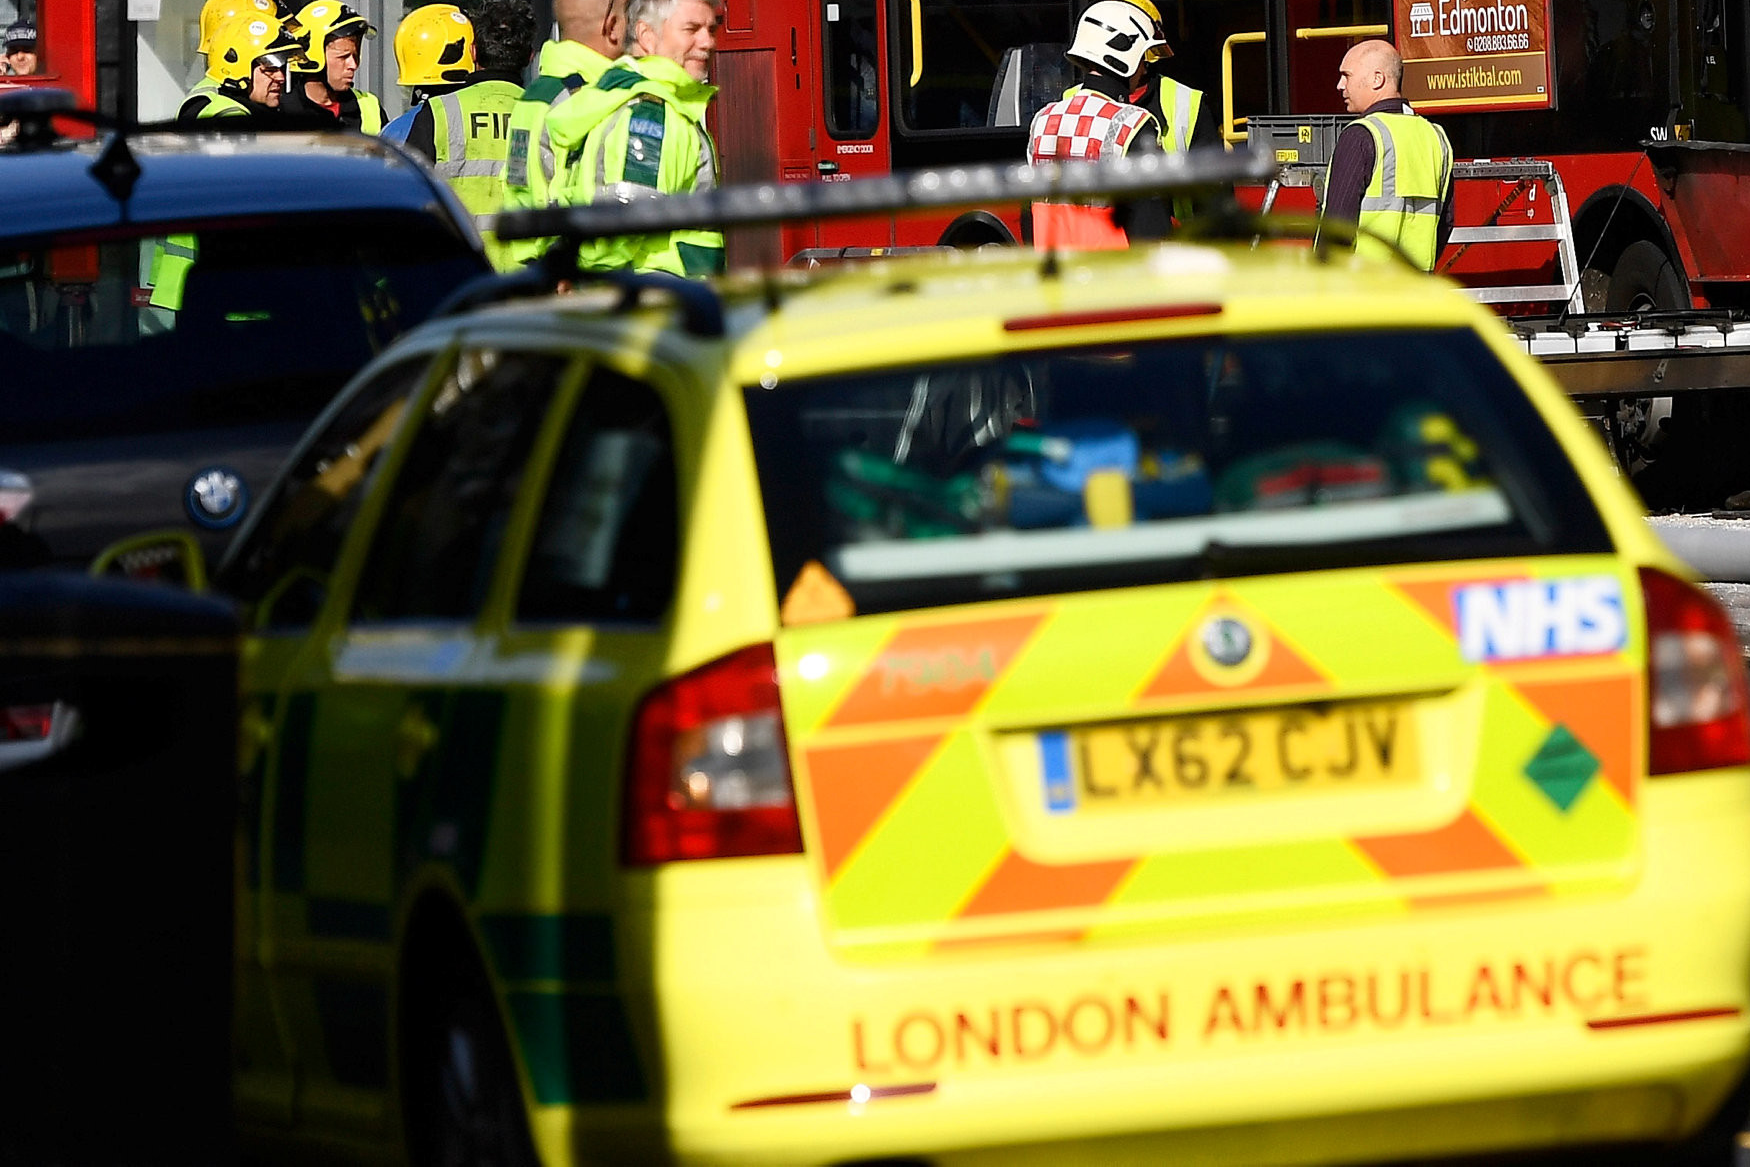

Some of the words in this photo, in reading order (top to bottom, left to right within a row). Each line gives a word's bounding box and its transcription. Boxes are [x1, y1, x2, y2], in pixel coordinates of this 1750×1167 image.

[1426, 65, 1522, 90] www.istikbal.com
[630, 118, 664, 139] NHS
[1456, 577, 1626, 662] NHS
[1077, 729, 1254, 799] LX62
[1277, 705, 1399, 783] CJV
[851, 989, 1171, 1078] LONDON
[1202, 946, 1652, 1046] AMBULANCE
